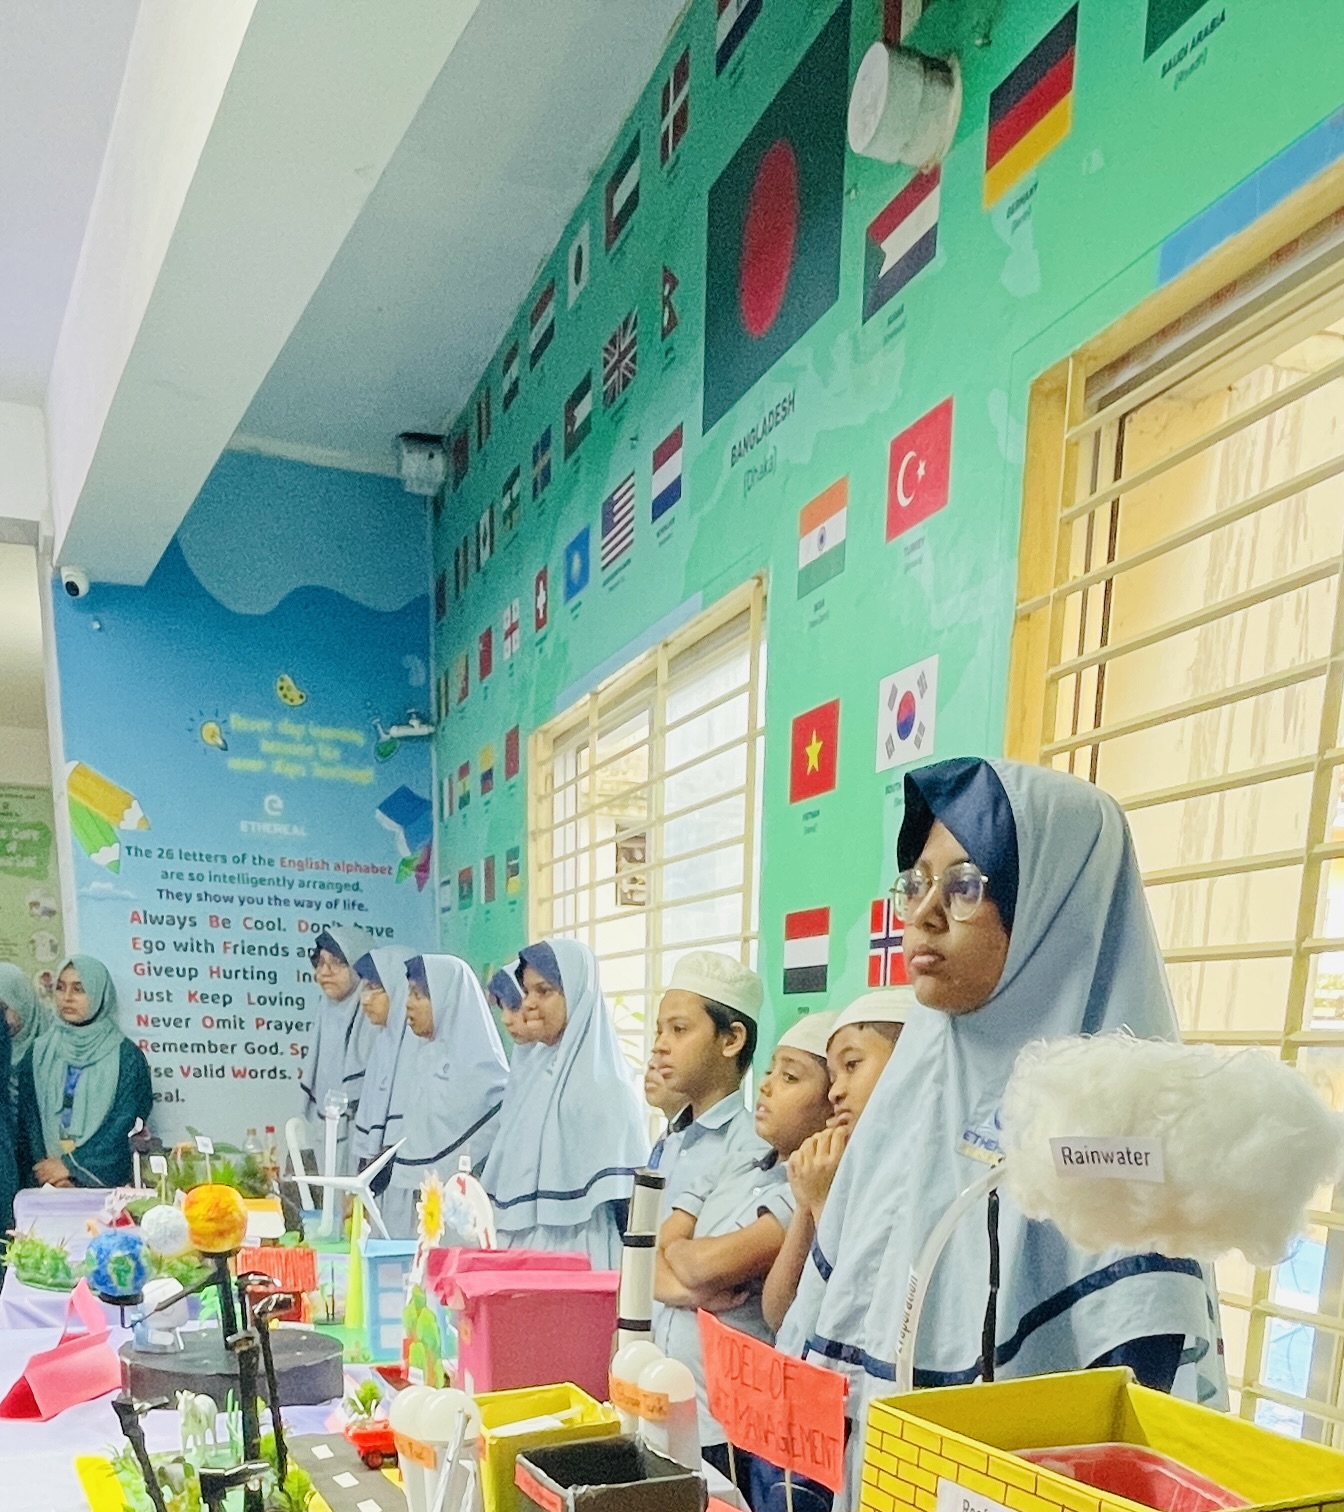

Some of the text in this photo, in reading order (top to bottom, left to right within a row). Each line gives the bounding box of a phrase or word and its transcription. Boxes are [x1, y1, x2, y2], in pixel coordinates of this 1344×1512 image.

[731, 388, 796, 468] BANGLADESH
[125, 845, 393, 876] The 26 letters of the English alphabet
[160, 870, 364, 894] are so intelligently arranged.
[157, 887, 369, 913] They show you the way of life.
[130, 910, 198, 930] Always
[208, 914, 232, 929] Be
[242, 917, 287, 932] Cool.
[131, 937, 166, 955] Ego
[173, 938, 215, 954] with
[222, 941, 289, 958] Friends
[133, 962, 199, 981] Giveup
[208, 965, 278, 985] Hurting
[135, 988, 306, 1011] Just Keep Loving
[136, 1014, 191, 1030] Never
[201, 1015, 246, 1031] Omit
[138, 1039, 237, 1055] Remember
[244, 1041, 284, 1056] God.
[179, 1064, 225, 1079] Valid
[231, 1065, 292, 1080] Words.
[152, 1088, 186, 1103] eal.
[1060, 1144, 1151, 1167] Rainwater
[714, 1335, 799, 1400] ODEL OF
